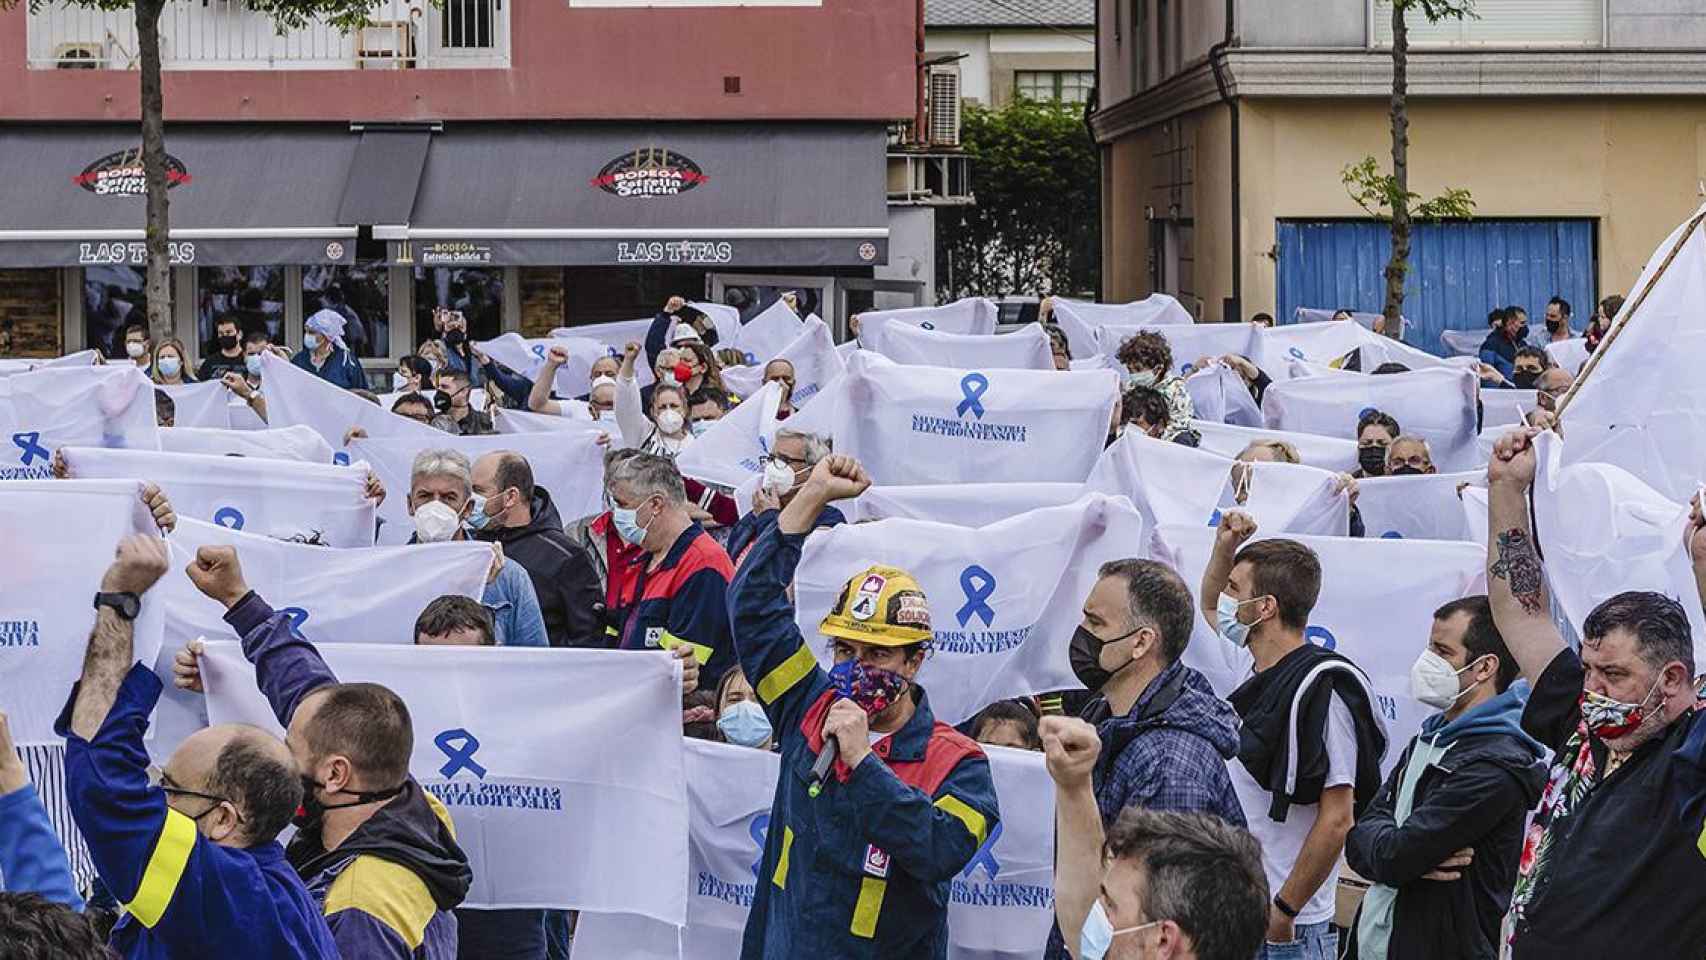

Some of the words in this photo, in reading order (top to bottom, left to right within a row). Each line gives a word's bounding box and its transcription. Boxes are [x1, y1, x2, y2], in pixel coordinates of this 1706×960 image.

[97, 167, 146, 180] BODE
[614, 169, 682, 181] BODEGA
[616, 178, 681, 190] Estrella
[617, 186, 679, 197] Galicia
[79, 242, 126, 263] LAS
[127, 242, 195, 263] TAS
[433, 242, 475, 253] BODEGA
[617, 241, 664, 263] LAS
[912, 415, 961, 428] SALVEMOS
[972, 421, 1026, 434] INDUSTRIA
[912, 421, 1026, 442] ELECTROINTENSIVA
[935, 631, 967, 642] EMOS
[970, 632, 978, 642] A
[698, 872, 754, 896] SALVEMO
[974, 883, 981, 895] A
[984, 884, 1053, 899] INDUSTRI
